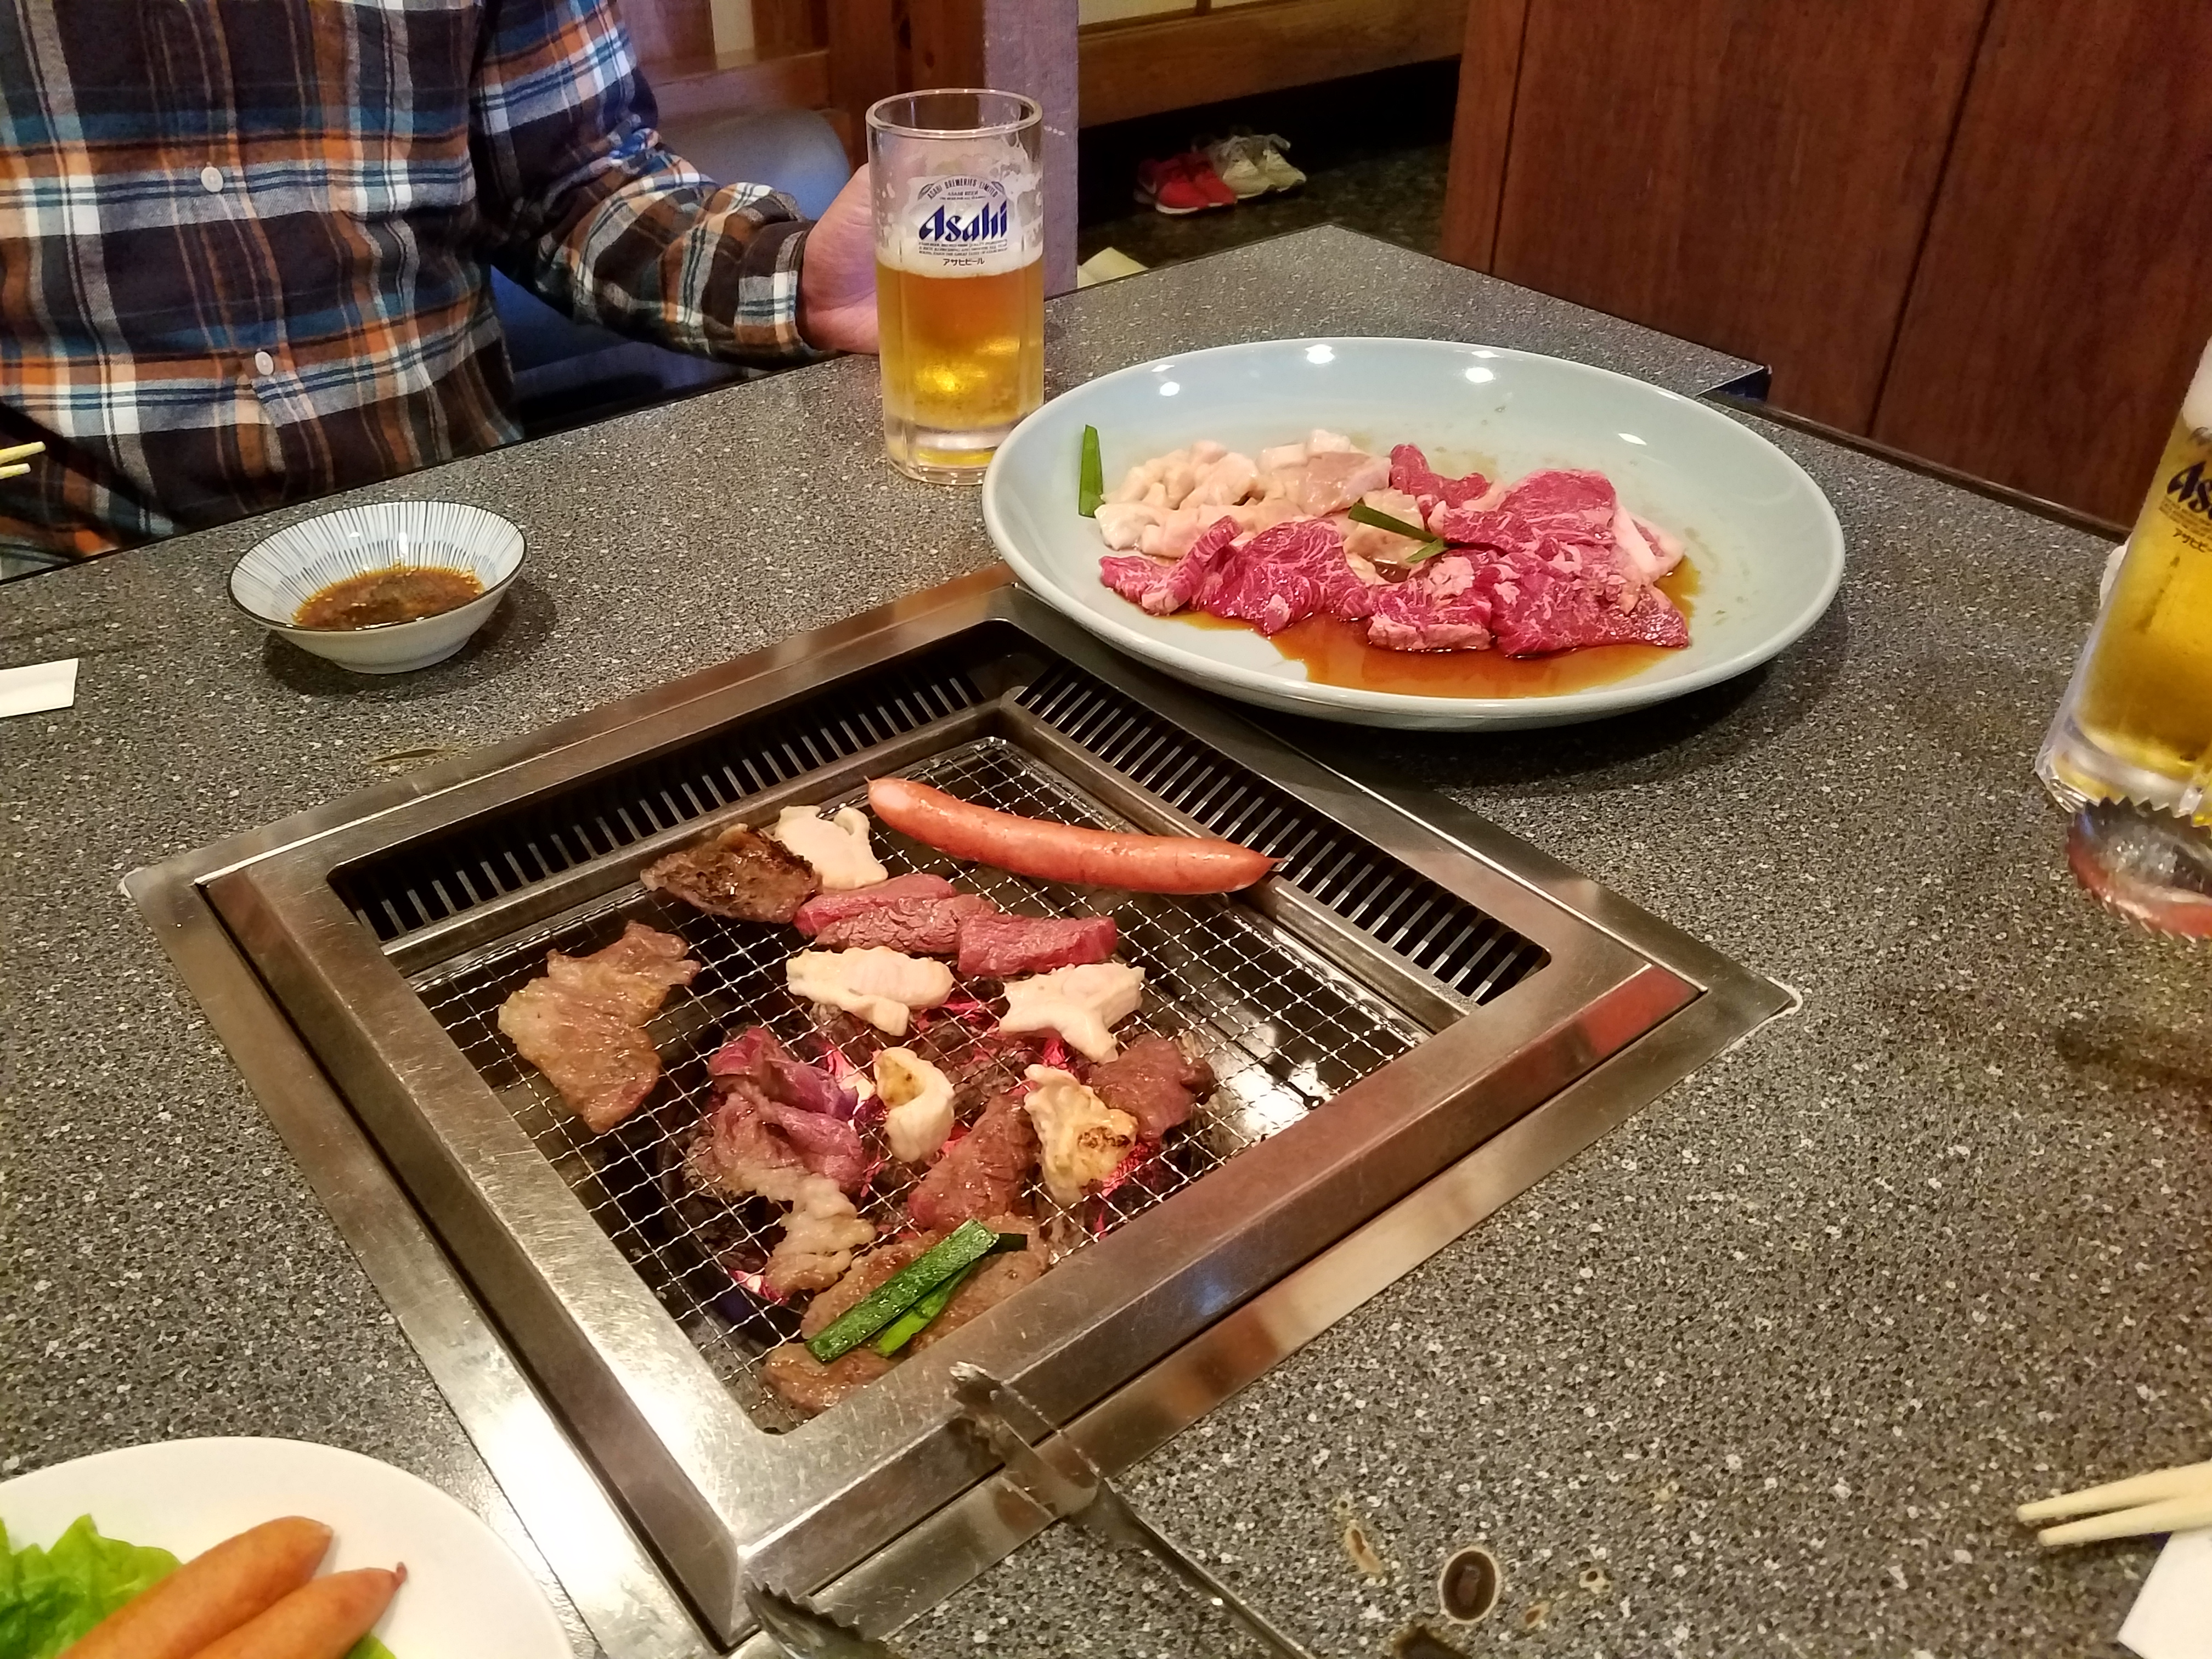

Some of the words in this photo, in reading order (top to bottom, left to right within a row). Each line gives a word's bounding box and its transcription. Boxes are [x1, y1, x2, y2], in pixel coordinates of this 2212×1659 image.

[944, 178, 977, 189] BREWERIES
[979, 182, 998, 198] LIMITED
[919, 200, 1008, 242] Asahi
[943, 257, 985, 266] アサヒビール
[2167, 460, 2212, 520] As
